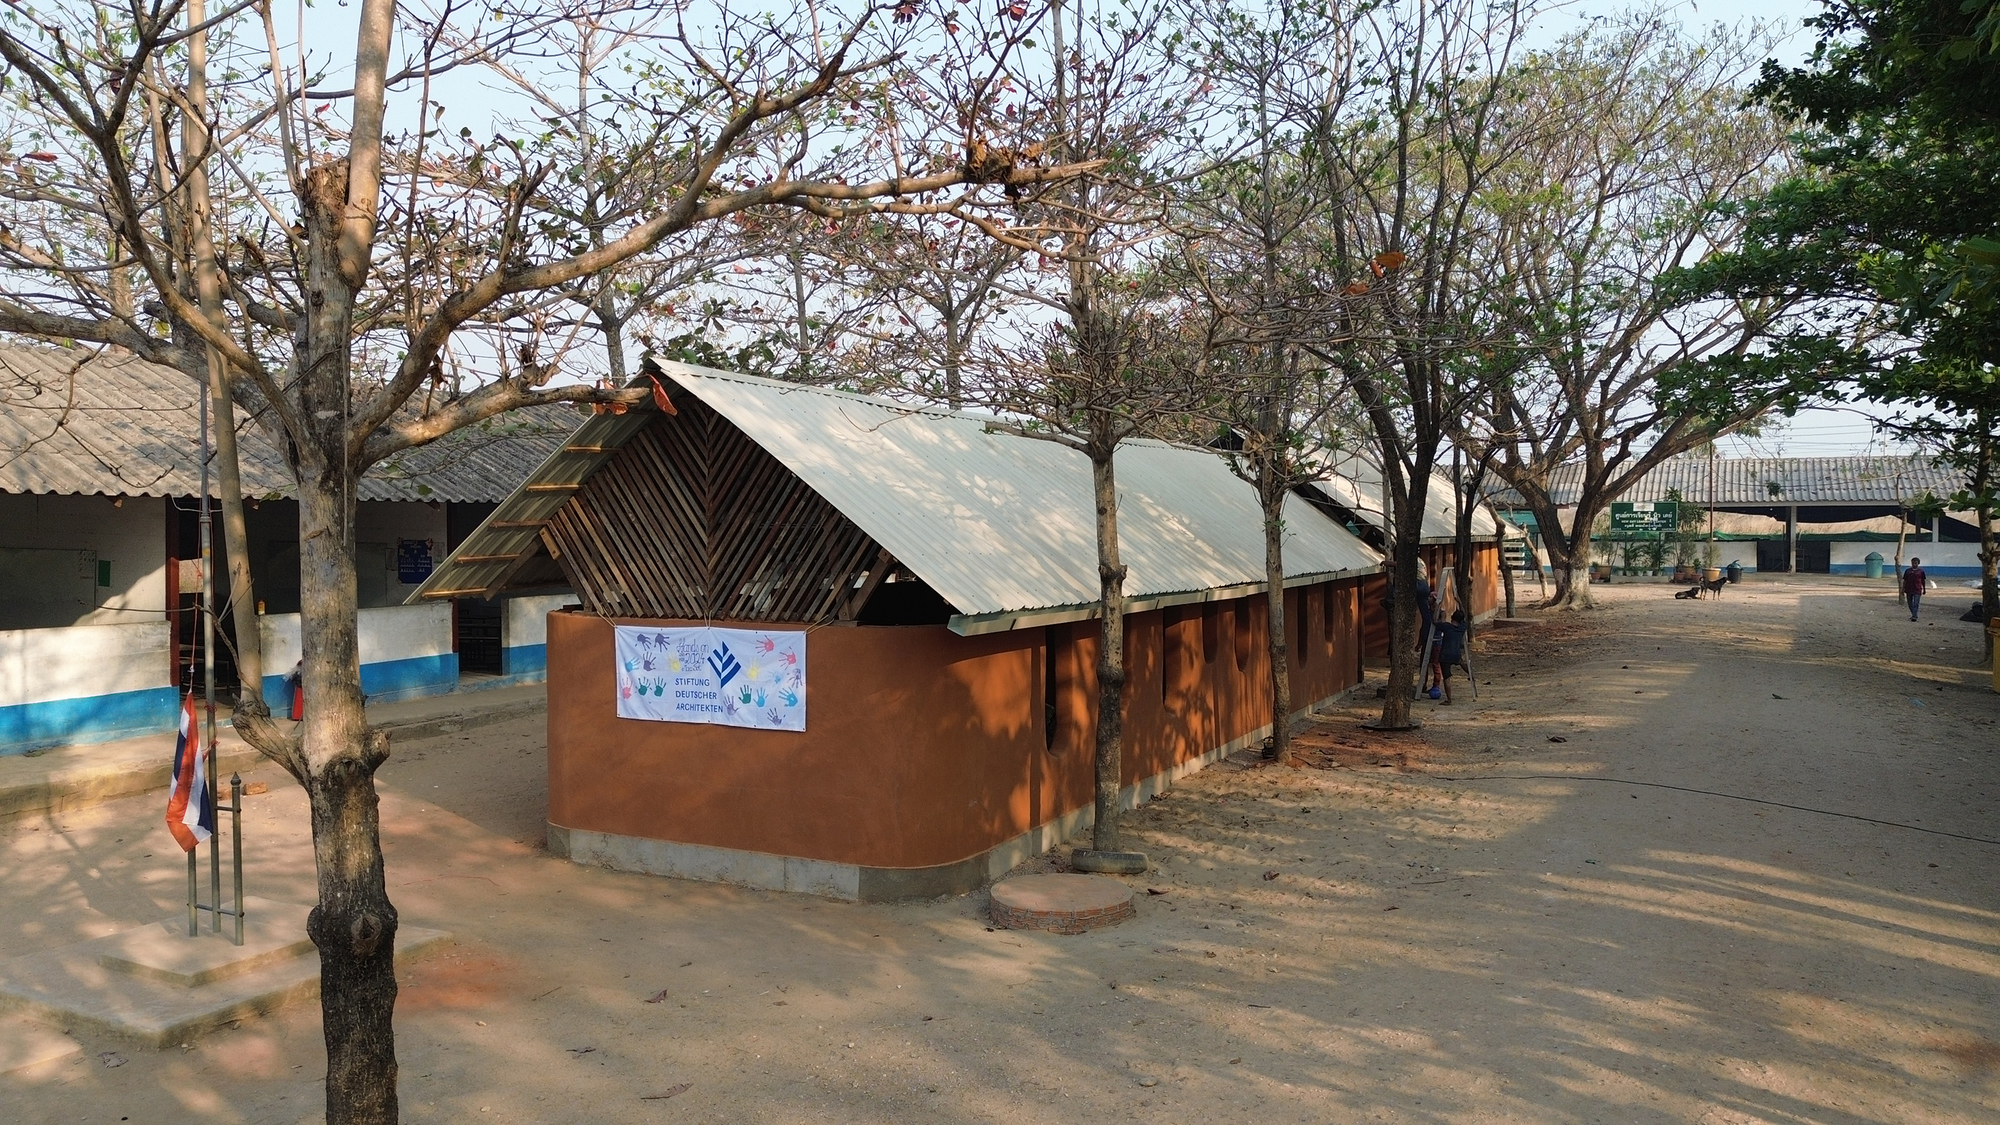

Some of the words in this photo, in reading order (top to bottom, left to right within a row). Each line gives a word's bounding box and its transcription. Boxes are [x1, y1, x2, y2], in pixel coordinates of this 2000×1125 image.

[676, 638, 699, 653] Hands
[700, 644, 710, 653] on
[684, 652, 705, 664] 2024
[675, 677, 710, 686] STIFTUNG
[675, 690, 717, 700] DEUTSCHER
[676, 703, 723, 713] ARCHITEKTEN
